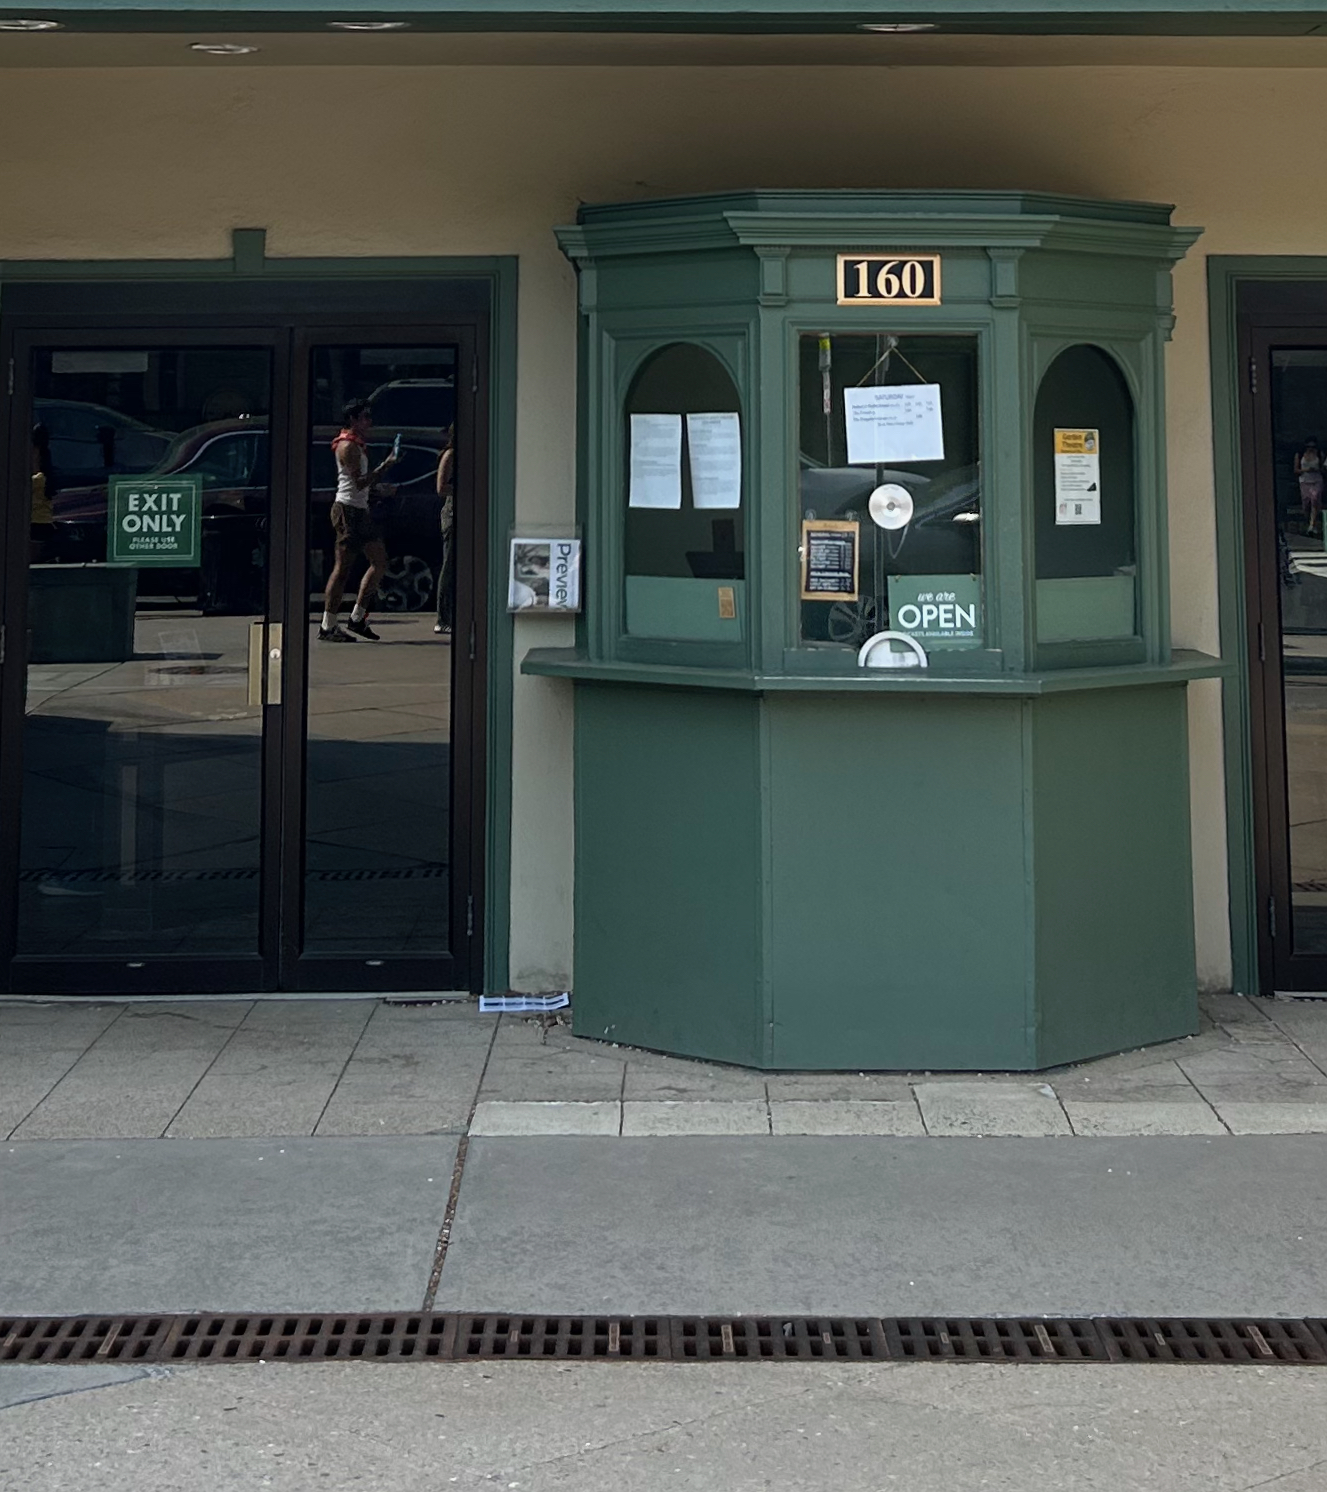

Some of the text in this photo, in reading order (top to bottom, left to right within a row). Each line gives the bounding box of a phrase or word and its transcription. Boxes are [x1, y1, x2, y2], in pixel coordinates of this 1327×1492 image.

[854, 261, 925, 297] 160
[128, 494, 182, 511] EXIT
[122, 514, 186, 532] ONLY
[917, 591, 956, 602] we are
[898, 604, 976, 628] OPEN
